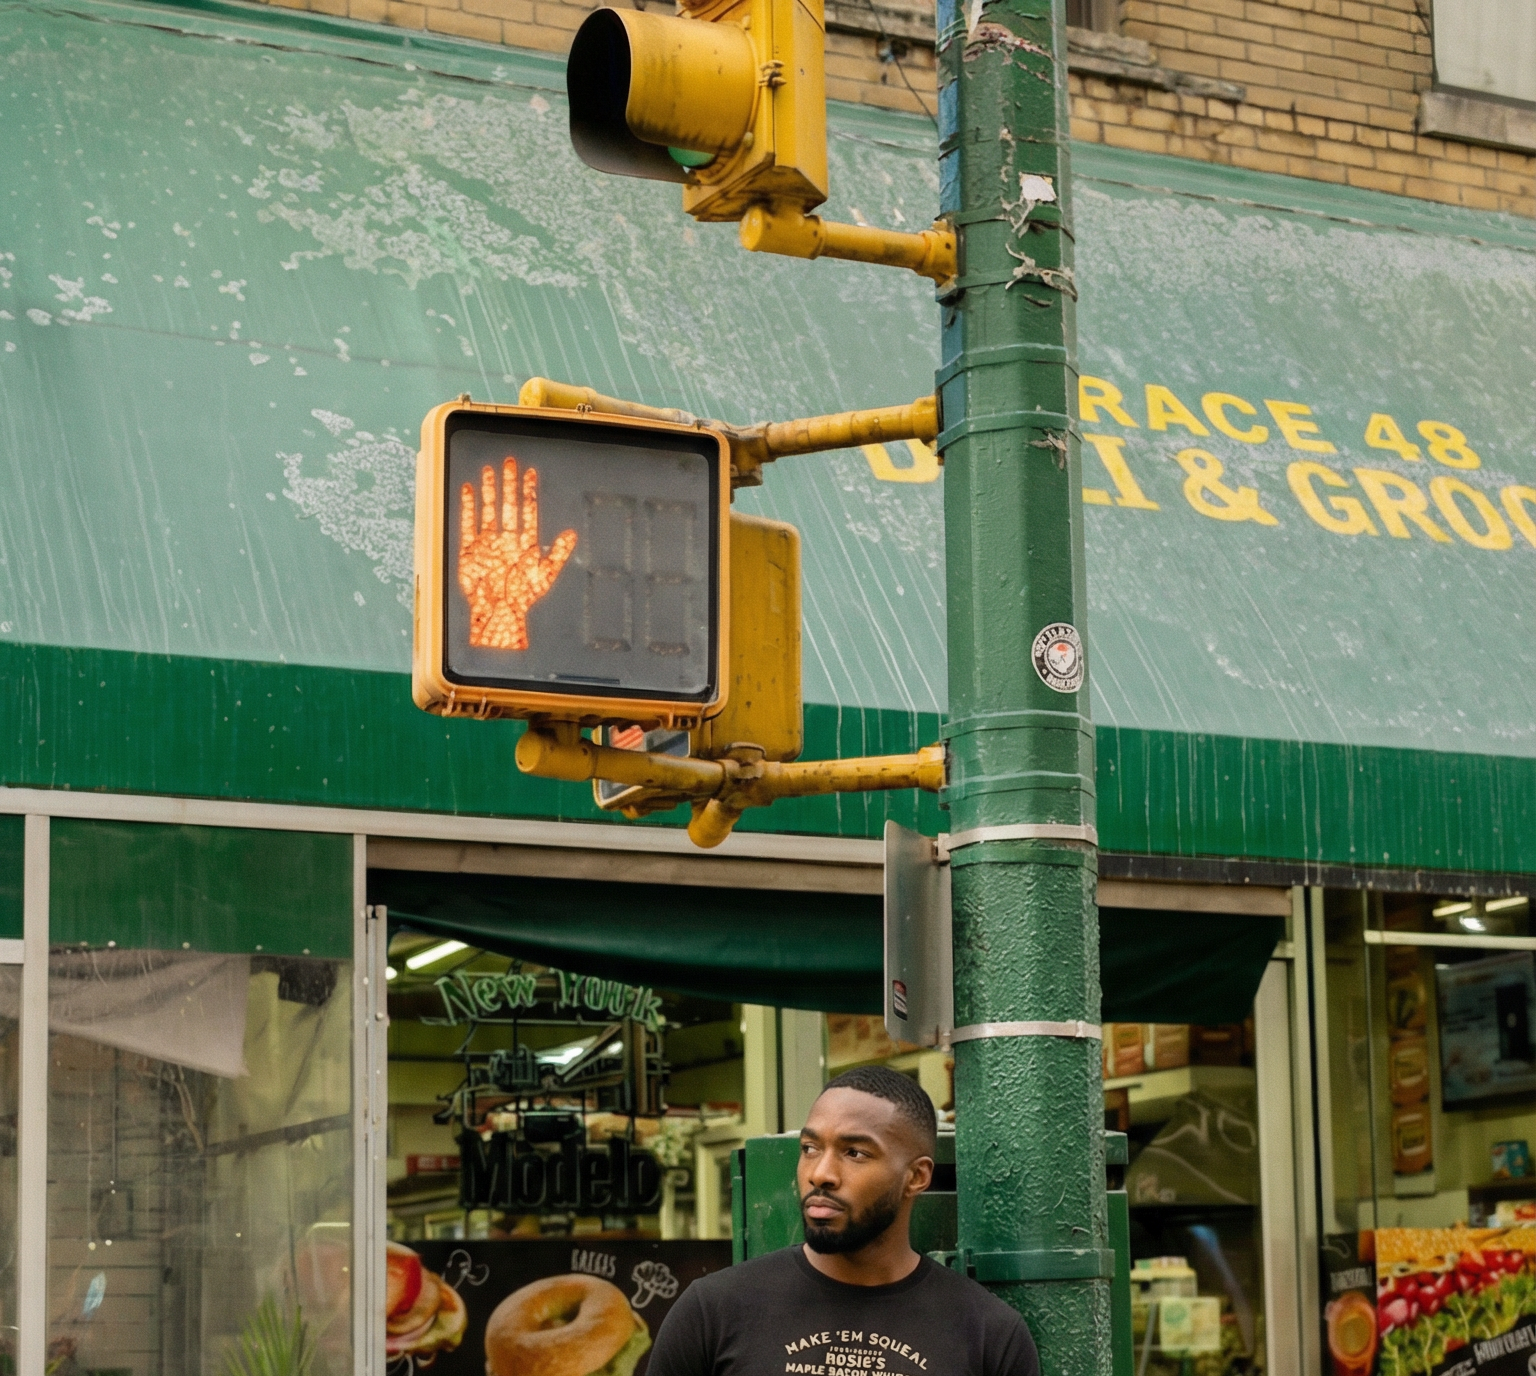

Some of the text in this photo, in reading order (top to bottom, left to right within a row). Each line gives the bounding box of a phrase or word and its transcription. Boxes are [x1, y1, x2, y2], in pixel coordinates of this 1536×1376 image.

[1363, 412, 1483, 471] 48
[1170, 447, 1280, 527] &
[433, 968, 537, 1027] New
[784, 1330, 928, 1371] MAKE 'EM SQUEAL
[785, 1362, 826, 1375] MAPLE
